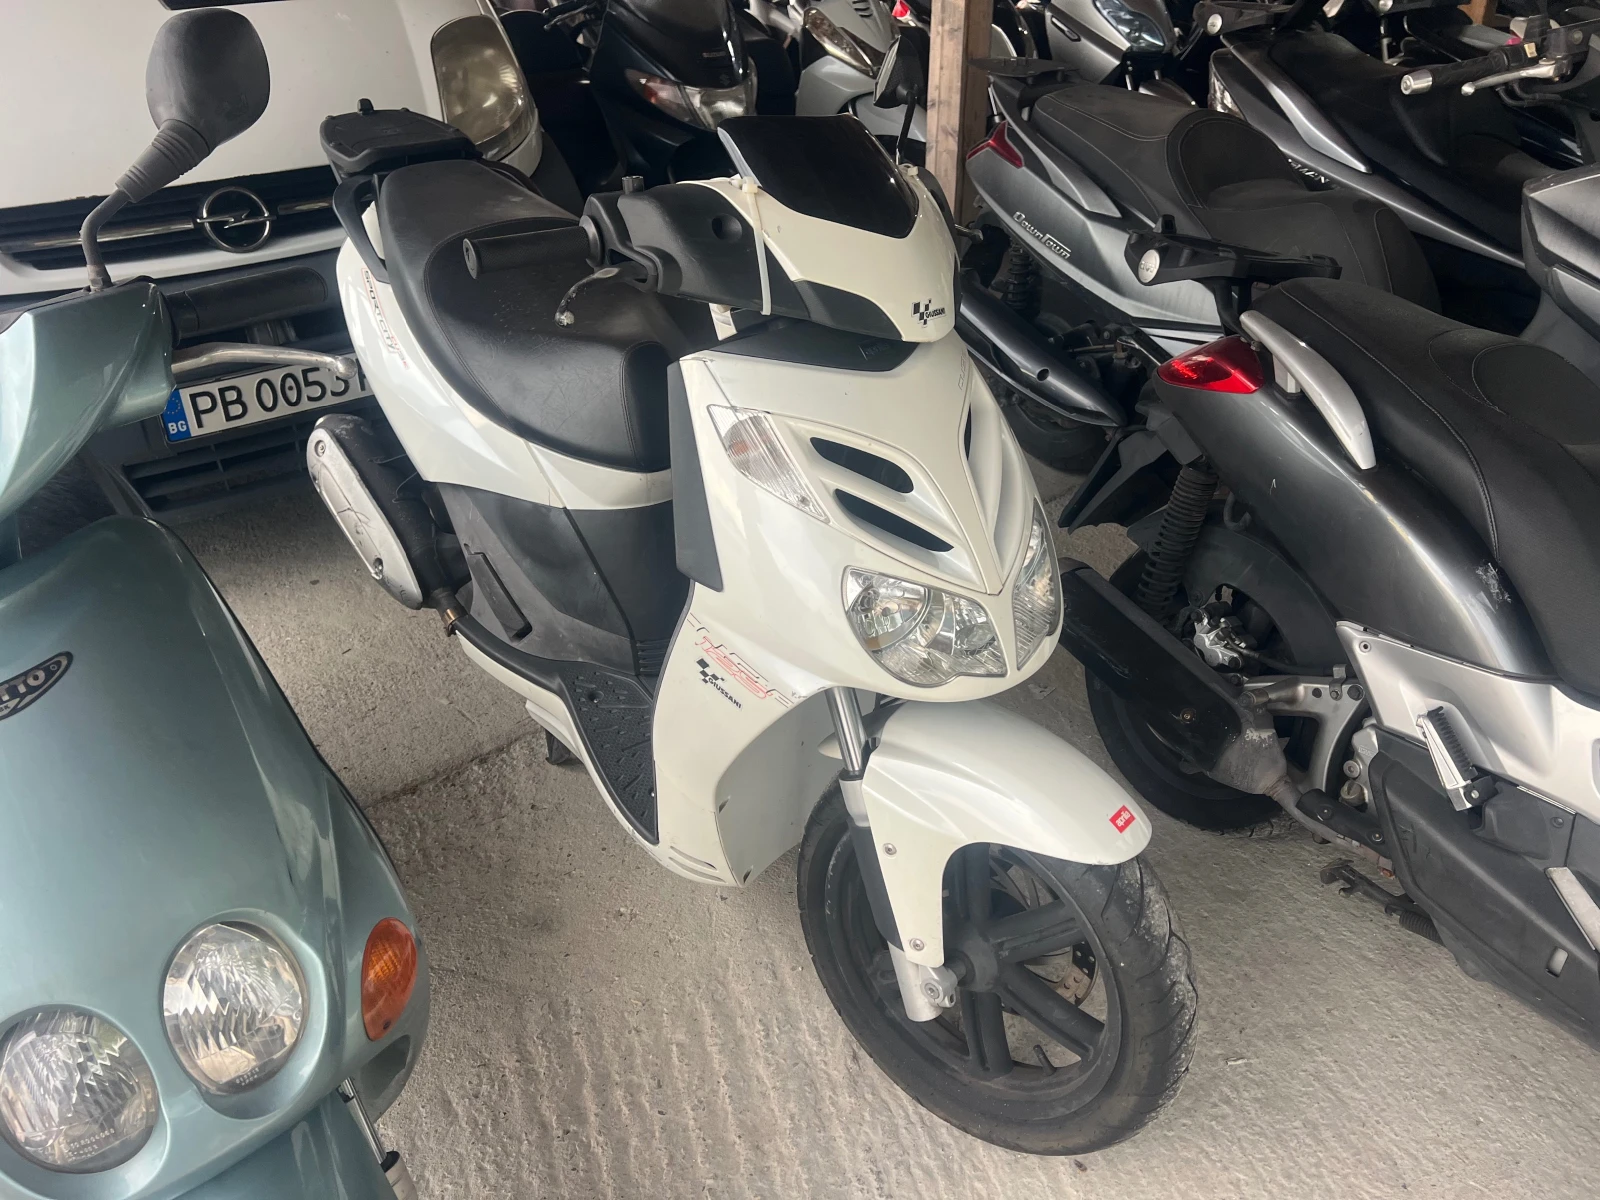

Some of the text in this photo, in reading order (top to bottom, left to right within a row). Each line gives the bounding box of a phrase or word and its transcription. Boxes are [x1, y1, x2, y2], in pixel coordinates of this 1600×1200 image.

[188, 385, 249, 429] PB
[168, 420, 187, 435] BG
[0, 668, 46, 702] TTO
[708, 677, 742, 709] GIUSSANI
